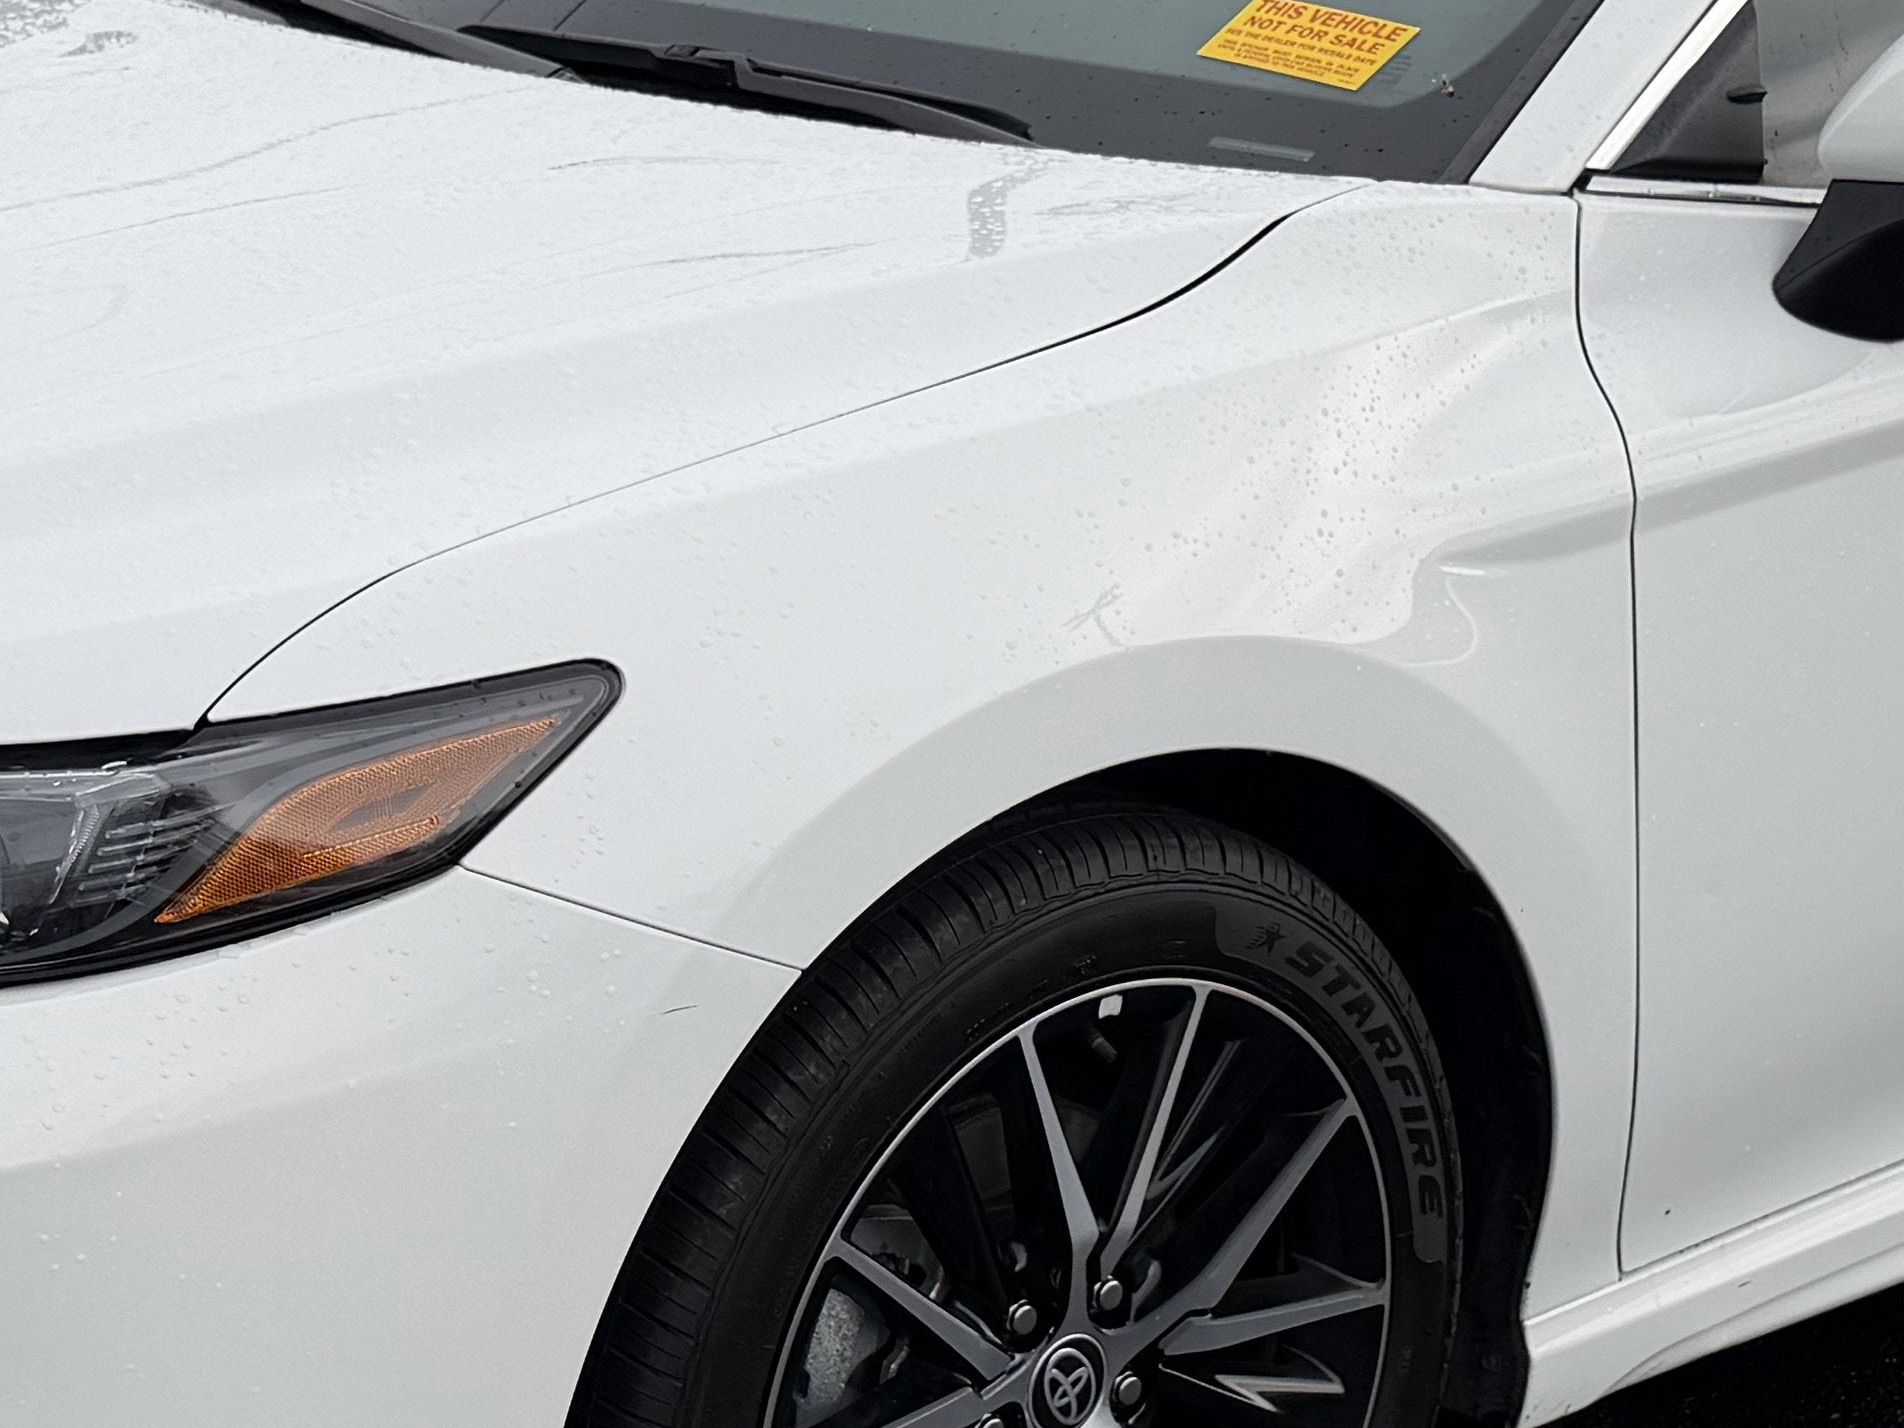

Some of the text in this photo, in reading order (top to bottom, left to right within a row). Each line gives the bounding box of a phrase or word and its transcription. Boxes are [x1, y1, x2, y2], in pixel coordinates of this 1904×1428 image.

[1243, 15, 1385, 55] NOT FOR SALE
[1308, 8, 1408, 43] VEHICLE
[1261, 35, 1297, 46] DEALER
[1296, 43, 1316, 51] FOR
[1352, 56, 1377, 65] DATE
[1285, 941, 1444, 1219] STARFIRE
